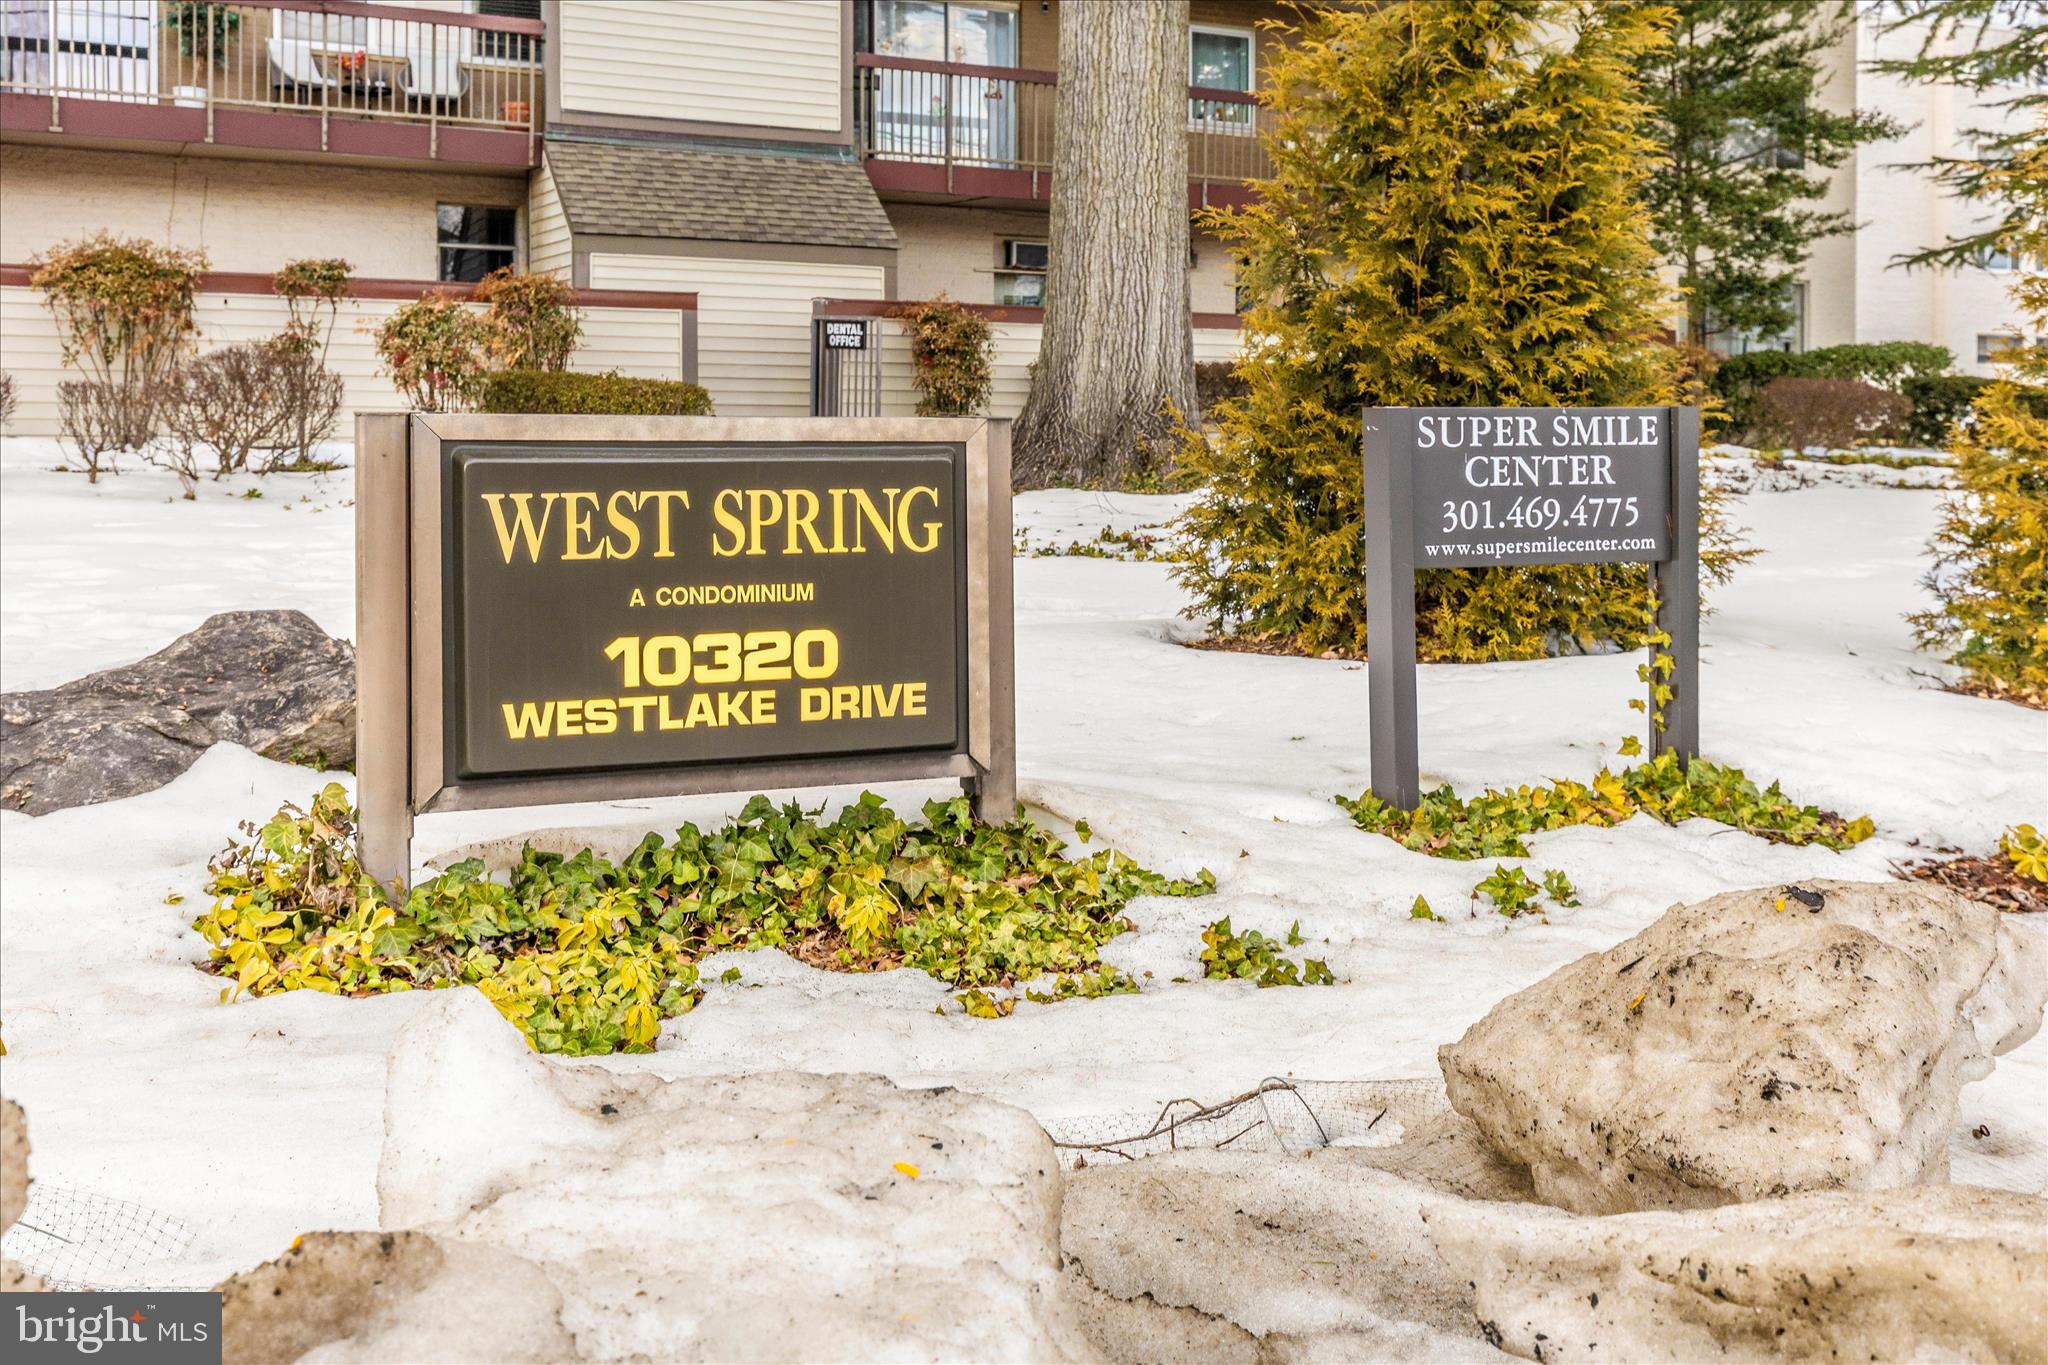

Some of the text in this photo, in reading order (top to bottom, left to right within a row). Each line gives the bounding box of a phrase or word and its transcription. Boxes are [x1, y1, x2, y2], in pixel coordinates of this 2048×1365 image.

[826, 323, 863, 335] DENTAL
[829, 335, 861, 347] OFFICE
[1417, 414, 1659, 448] SUPER SMILE
[1465, 454, 1616, 488] CENTER
[481, 485, 943, 564] WEST SPRING
[1442, 494, 1640, 533] 301.469.4775
[1425, 536, 1656, 559] www.supersmilecenter.com
[629, 583, 814, 607] A CONDOMINIUM
[603, 628, 839, 688] 10320
[502, 682, 927, 740] WESTLAKE DRIVE
